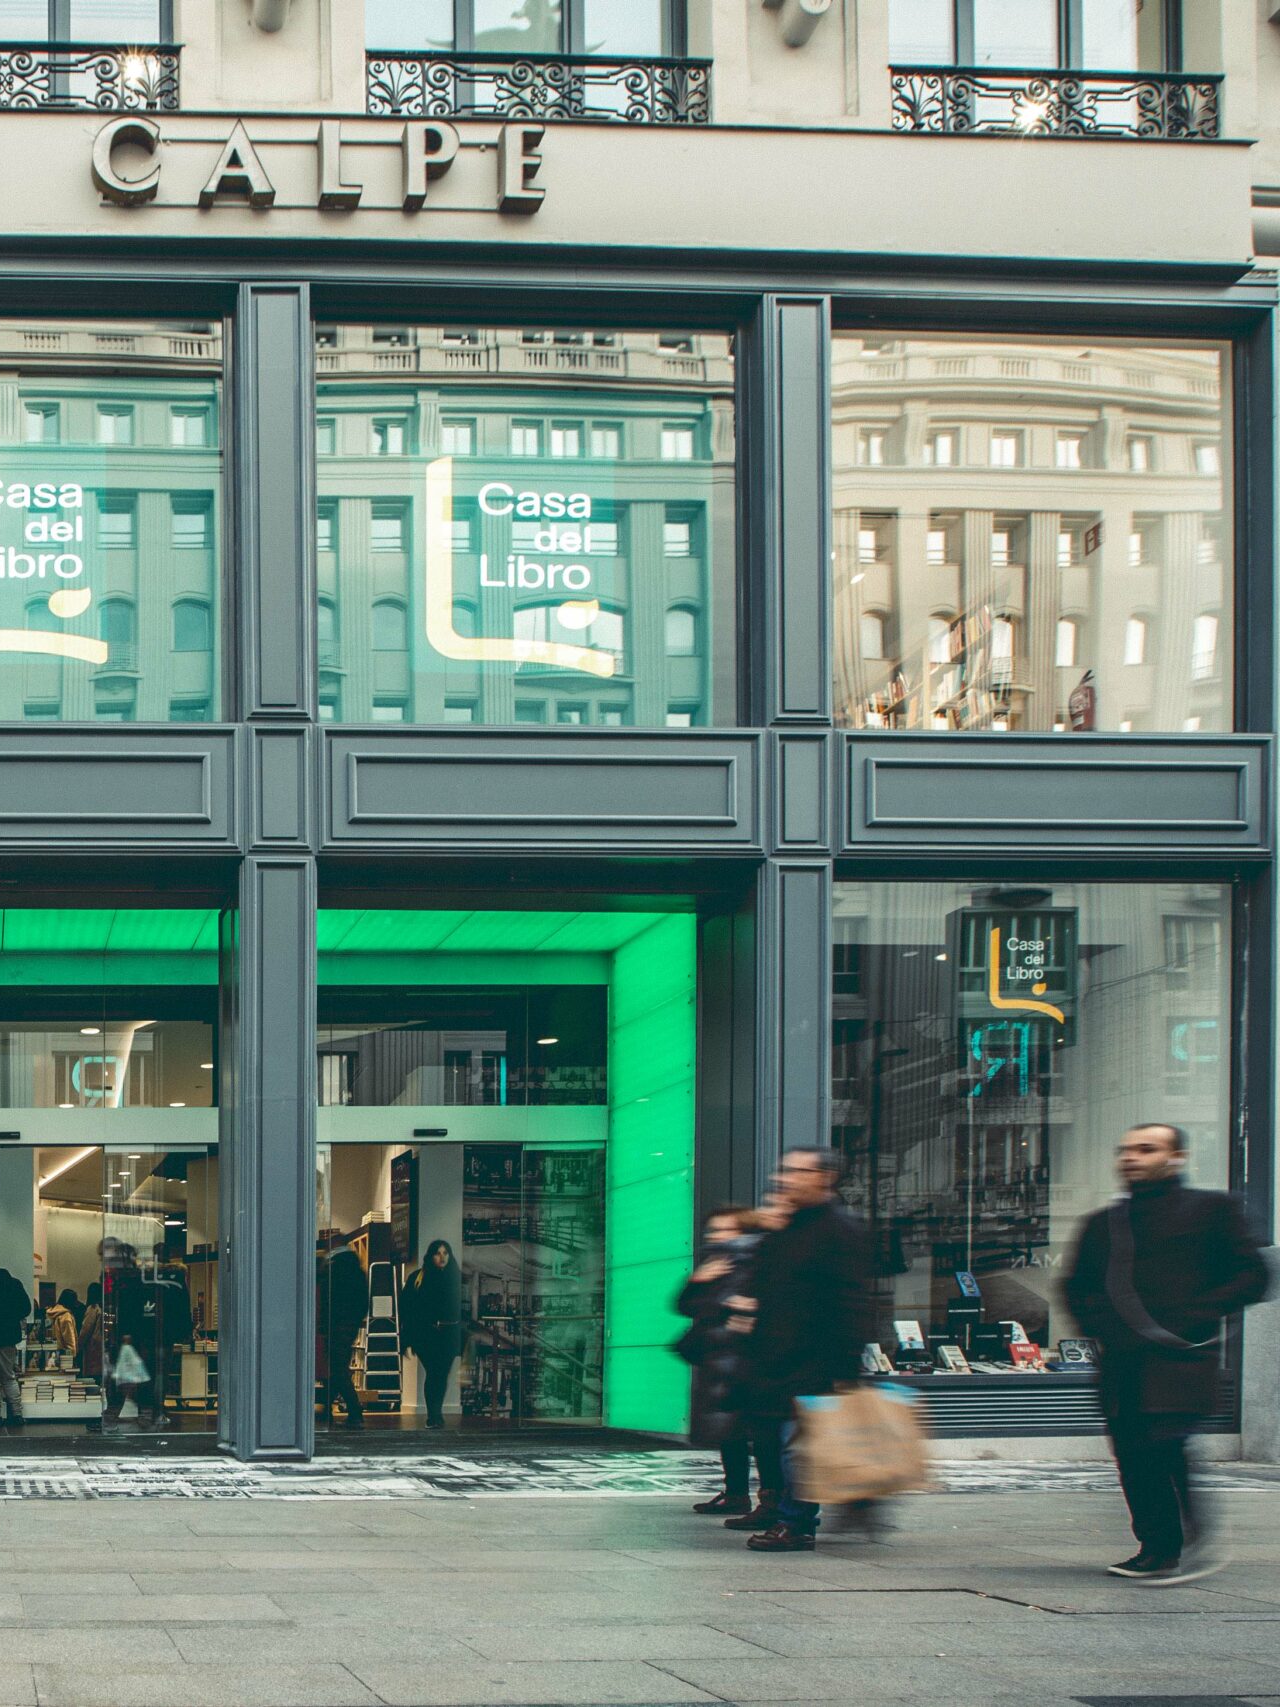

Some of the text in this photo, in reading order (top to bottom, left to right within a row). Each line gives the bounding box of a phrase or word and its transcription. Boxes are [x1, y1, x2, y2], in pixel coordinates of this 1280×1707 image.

[91, 116, 546, 214] CALPE
[478, 482, 591, 518] Casa
[24, 515, 83, 542] del
[534, 525, 591, 553] del
[480, 554, 591, 590] Libro
[1006, 937, 1044, 951] Casa
[1006, 966, 1044, 980] Libro
[1024, 954, 1044, 965] del
